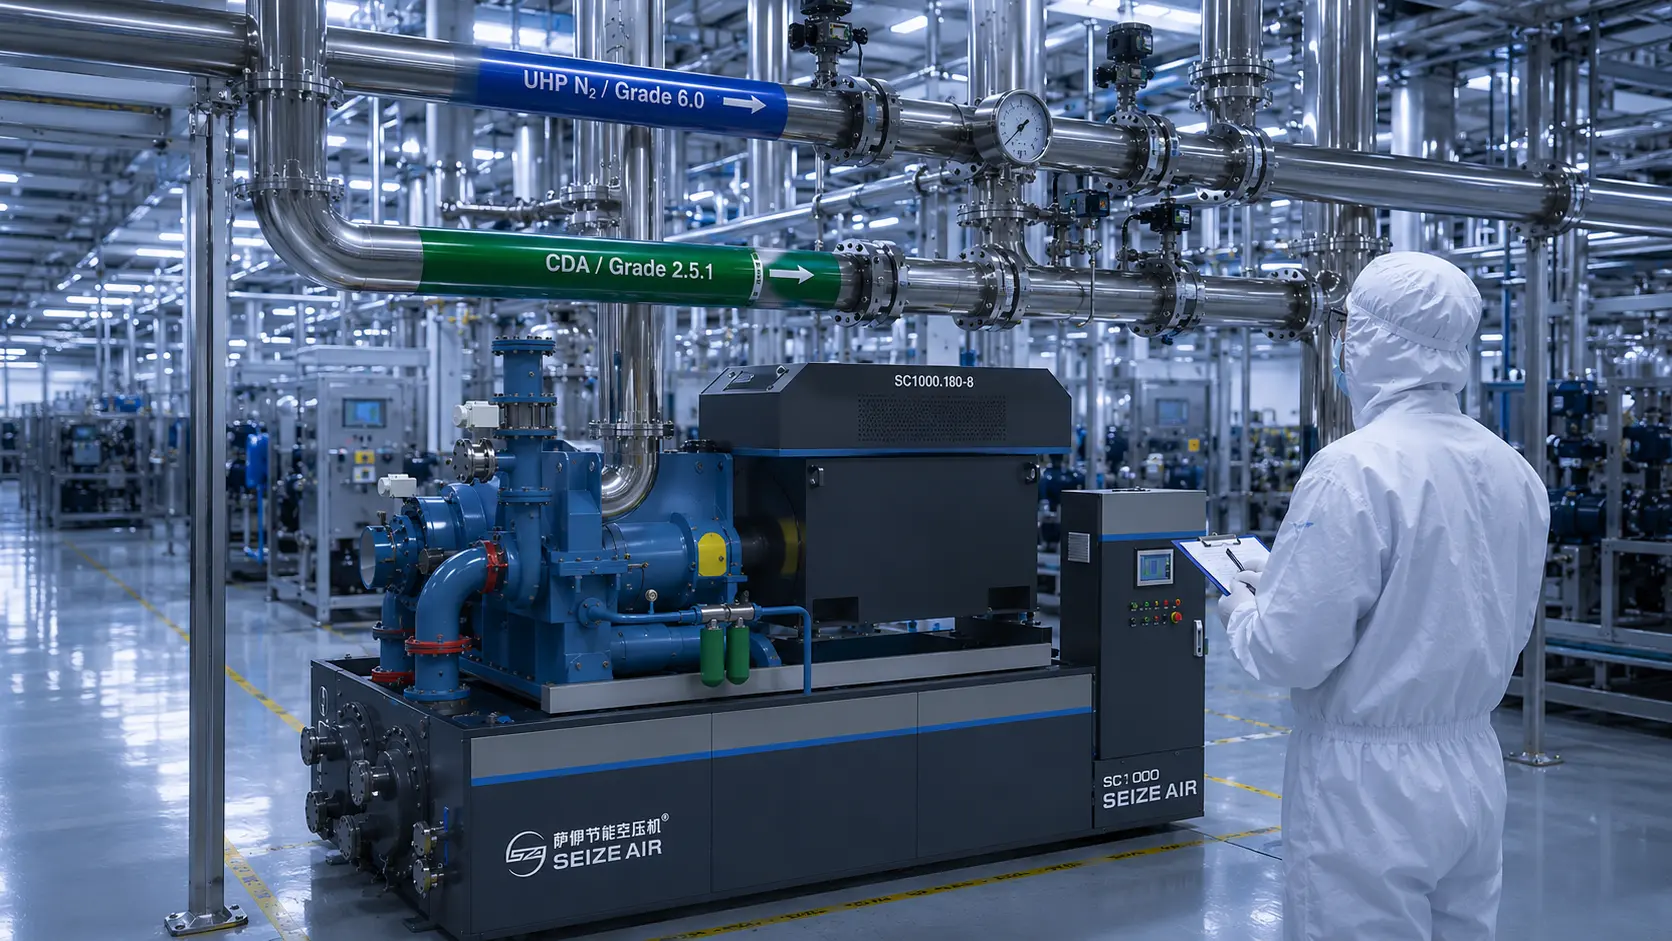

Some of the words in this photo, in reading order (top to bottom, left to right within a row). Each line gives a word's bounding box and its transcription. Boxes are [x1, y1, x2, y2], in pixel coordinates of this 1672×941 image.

[523, 69, 568, 92] UHP
[601, 79, 609, 98] /
[615, 81, 672, 105] Grade
[677, 90, 705, 109] 6.0
[545, 253, 591, 274] CDA
[595, 256, 603, 274] /
[608, 257, 667, 278] Grade
[672, 261, 713, 280] 2.5.1
[894, 374, 974, 388] SC1000.180-8
[1103, 785, 1161, 809] SEIZE
[1165, 780, 1197, 800] AIR
[553, 845, 622, 870] SEIZE
[625, 839, 663, 860] AIR
